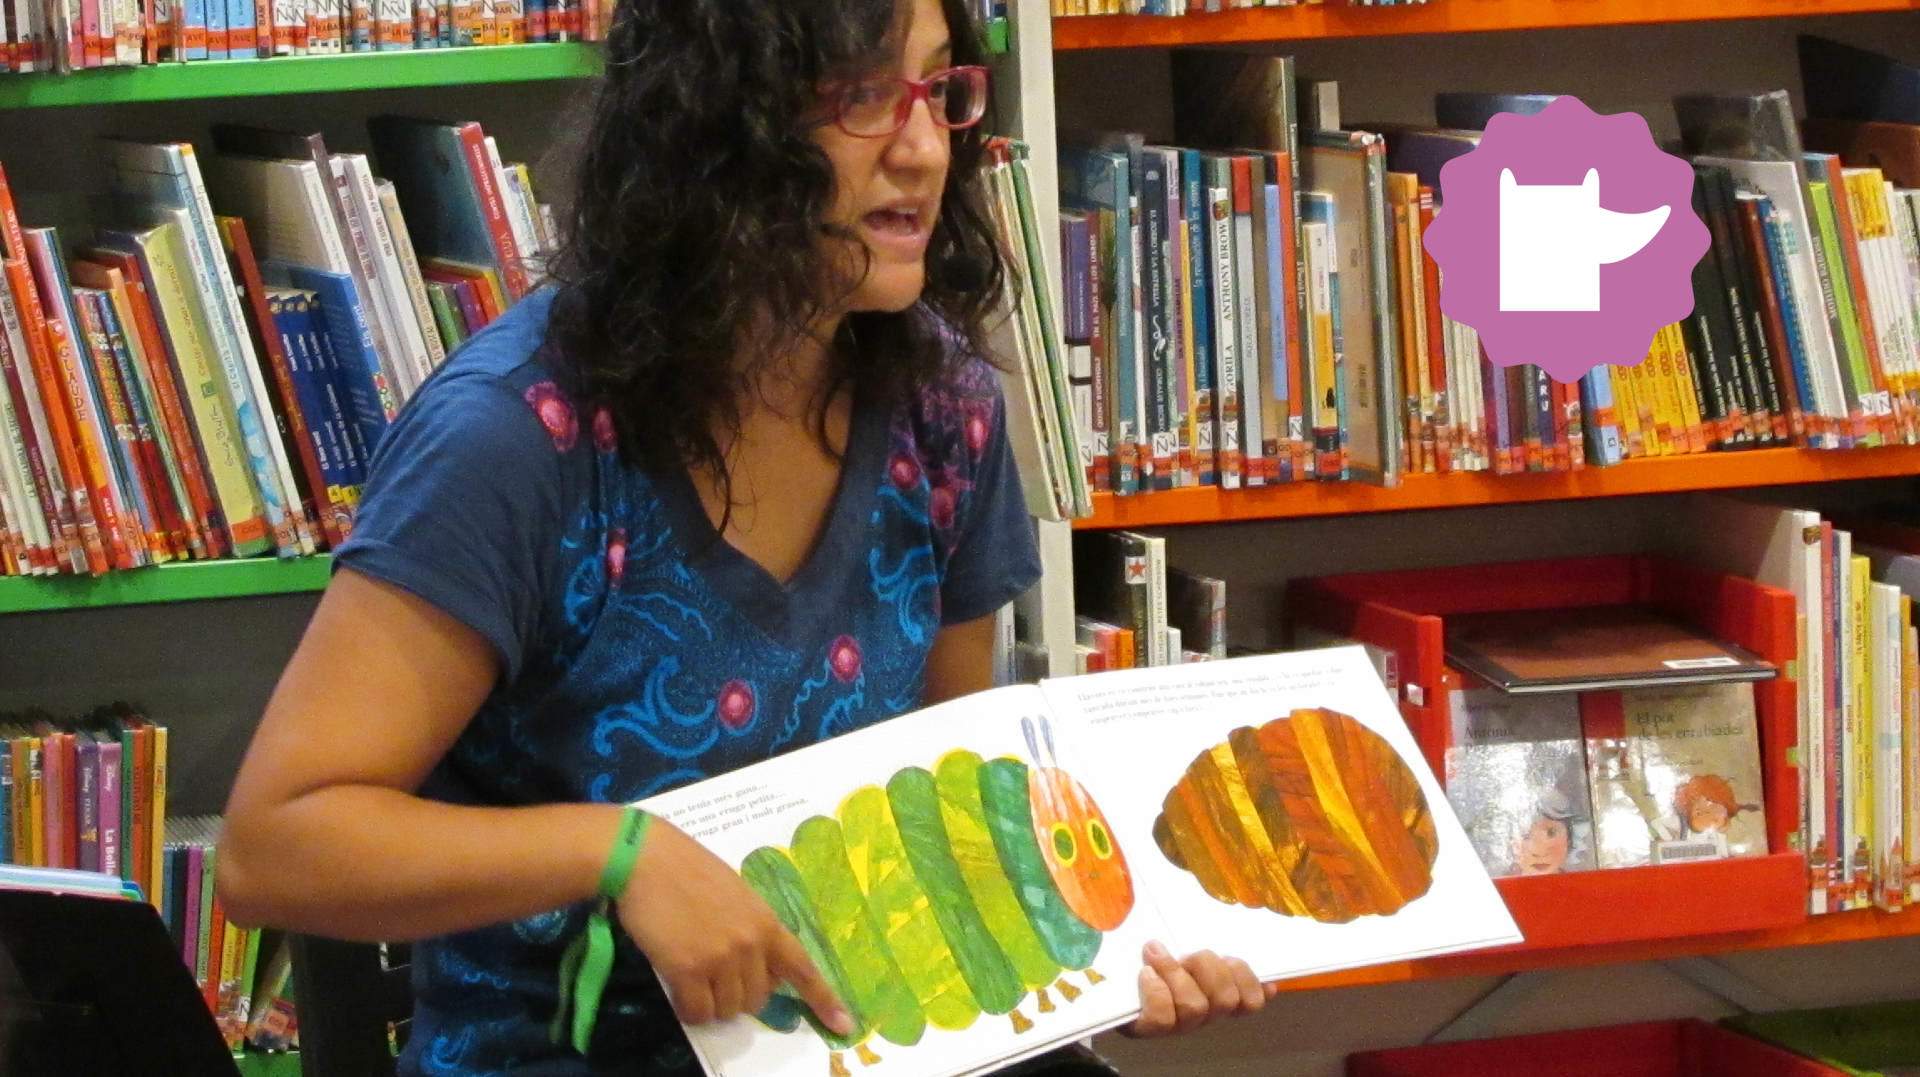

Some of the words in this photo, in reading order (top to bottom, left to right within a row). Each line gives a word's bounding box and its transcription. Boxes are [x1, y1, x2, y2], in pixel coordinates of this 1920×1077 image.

[1219, 261, 1232, 320] ANTHONY
[718, 803, 746, 820] eruga
[721, 817, 743, 832] gran
[105, 829, 115, 843] La
